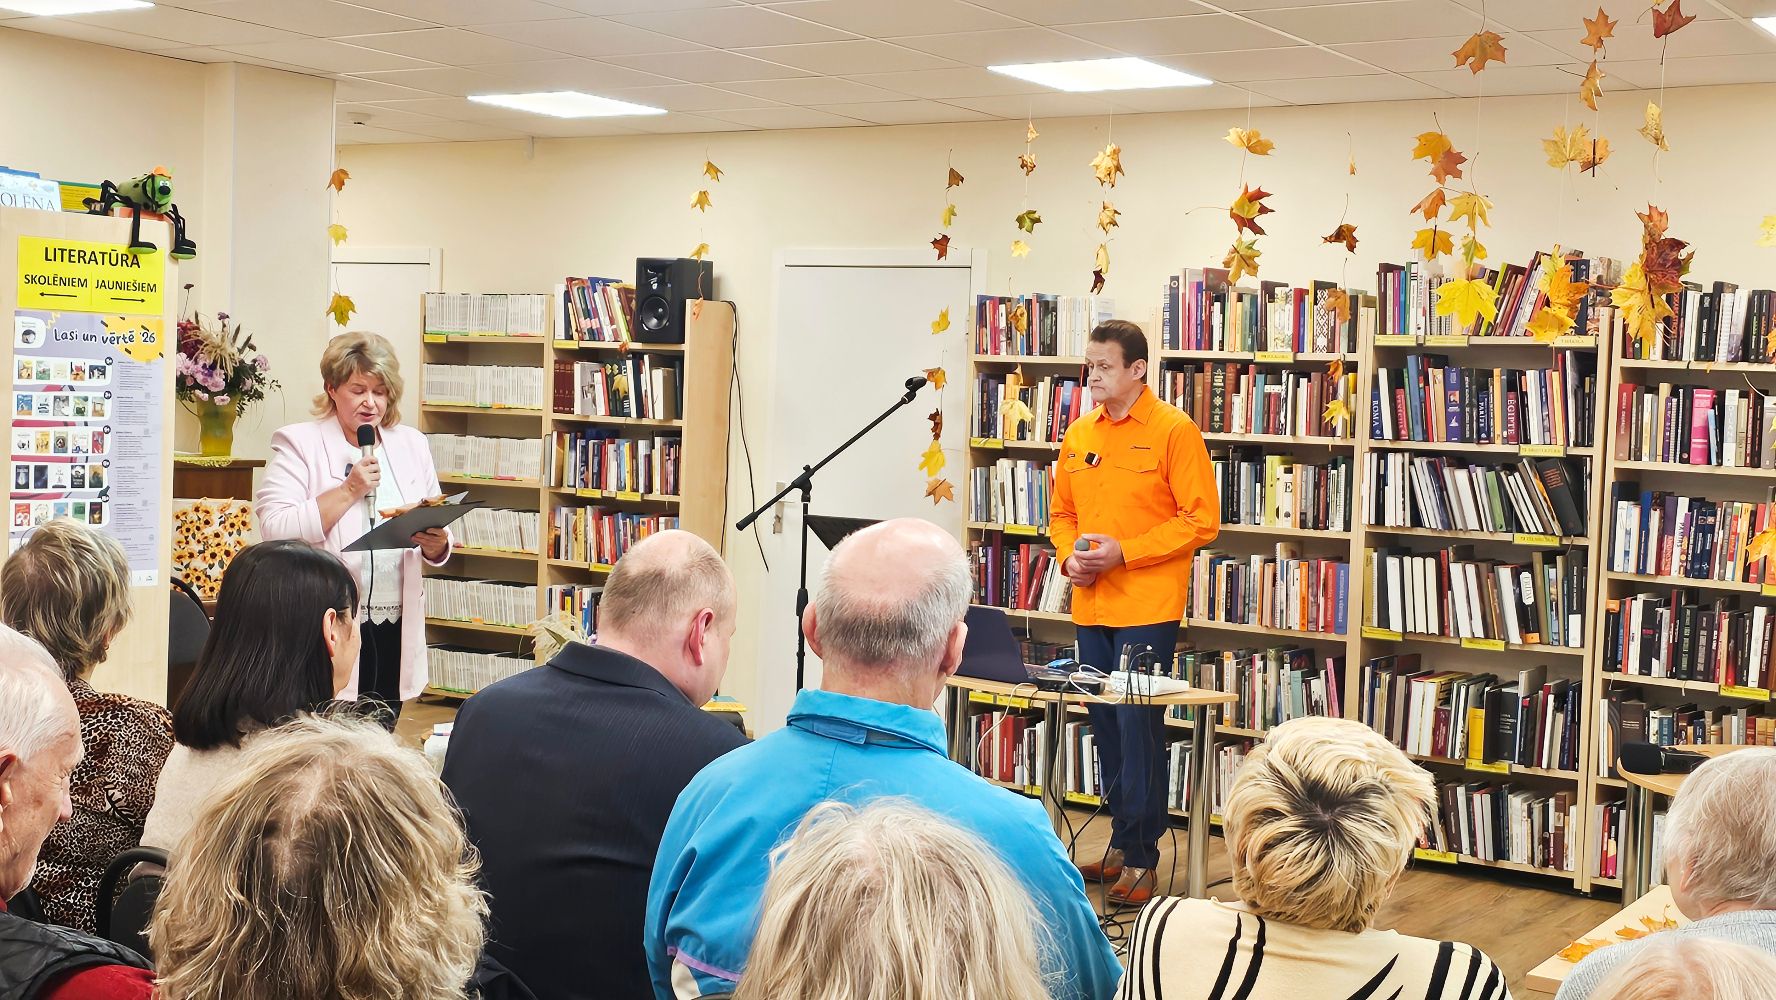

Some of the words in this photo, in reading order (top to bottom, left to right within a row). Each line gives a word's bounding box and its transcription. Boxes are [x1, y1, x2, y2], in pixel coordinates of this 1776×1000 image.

[44, 246, 141, 269] LITERATŪRA
[24, 273, 88, 288] SKOLĒNIEM
[95, 279, 157, 293] JAUNIEŠIEM
[54, 328, 78, 342] Lasi
[82, 332, 98, 343] un
[101, 330, 135, 345] vērtē
[139, 331, 156, 344] '26
[1372, 400, 1380, 427] ROMA
